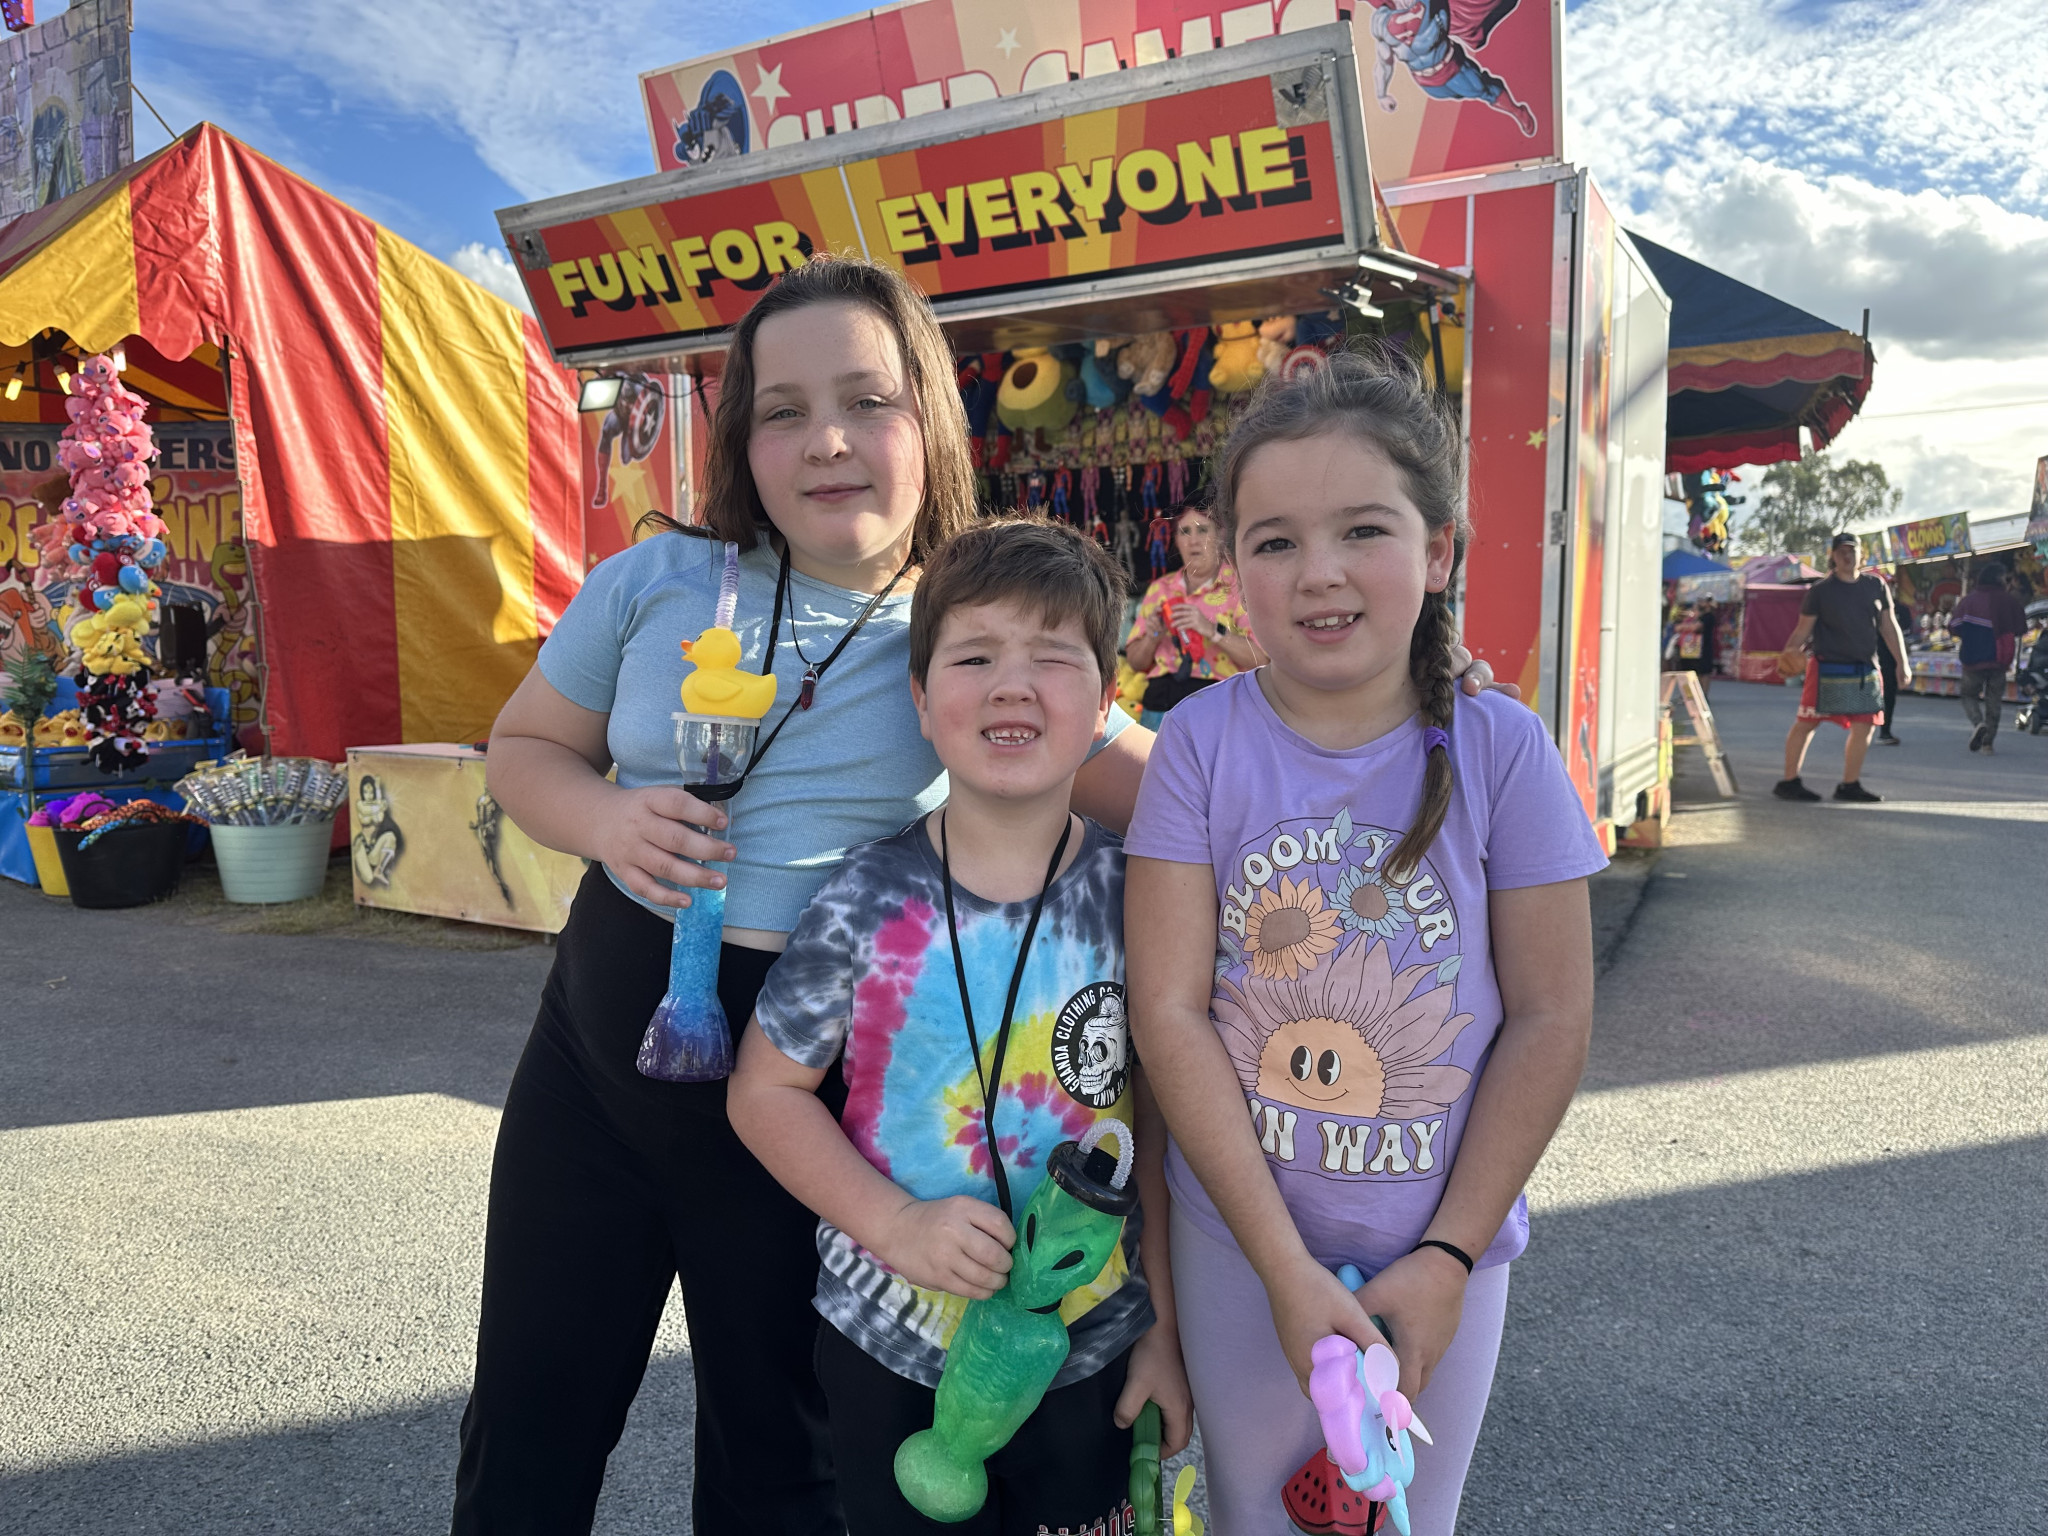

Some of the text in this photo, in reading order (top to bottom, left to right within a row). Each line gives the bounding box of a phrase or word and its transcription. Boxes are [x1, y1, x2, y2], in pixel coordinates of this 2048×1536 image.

[549, 126, 1296, 309] FUN FOR EVERYONE
[0, 437, 236, 471] NO ERS
[1907, 524, 1947, 551] CLOWNS
[1222, 827, 1342, 941] BLOOM
[1056, 988, 1096, 1040] CLOTHING
[1054, 1044, 1080, 1092] GHANDA
[1317, 1118, 1443, 1176] WAY
